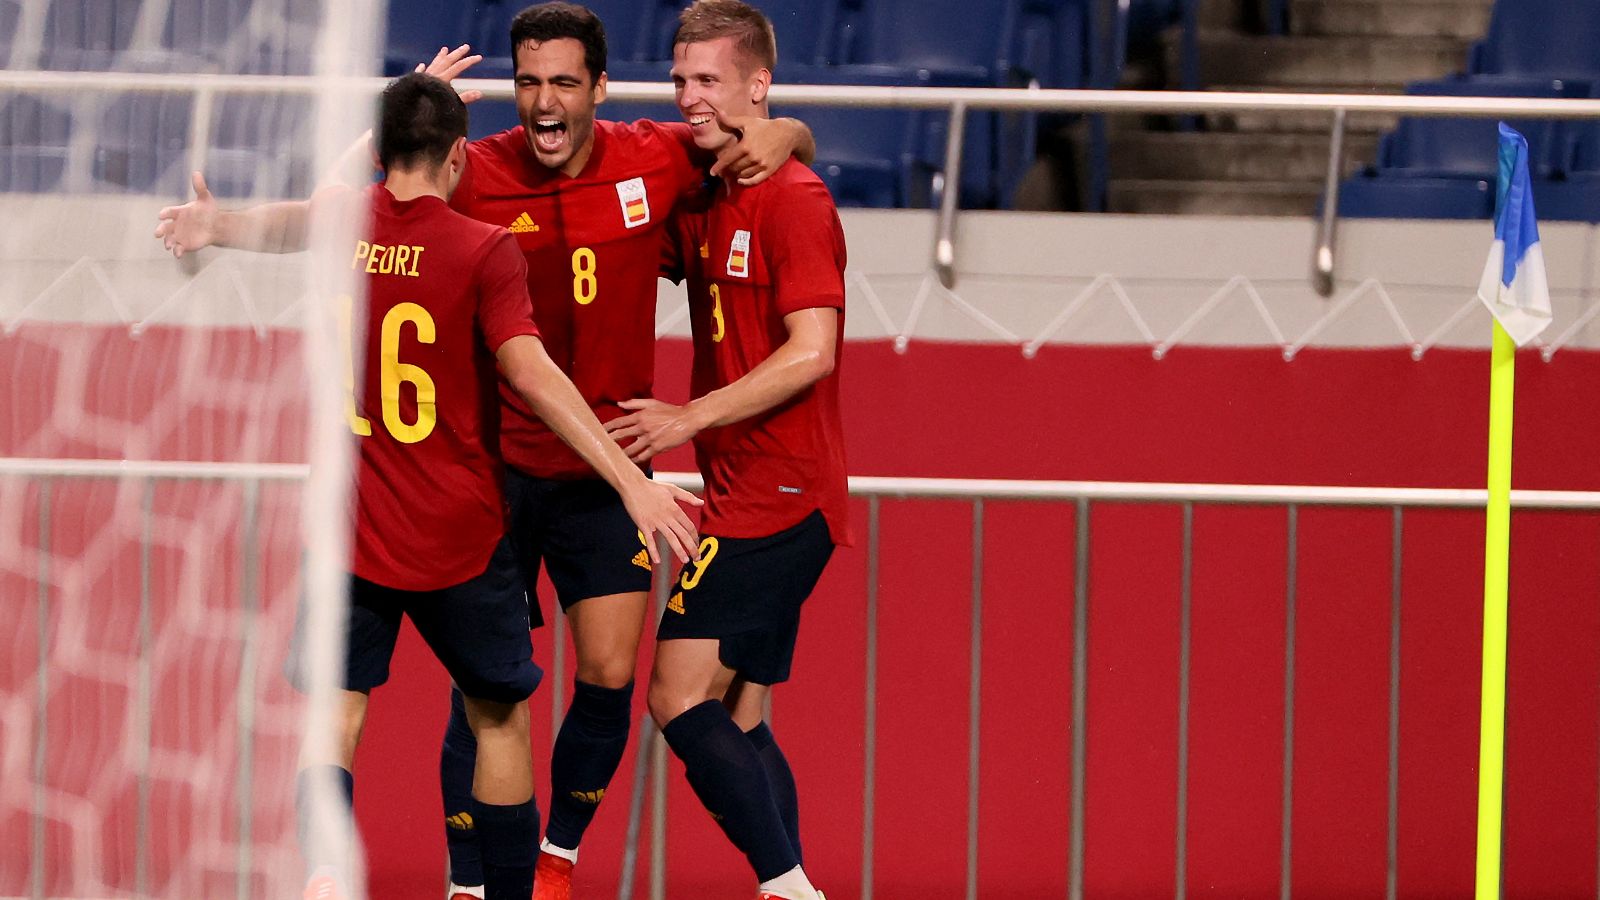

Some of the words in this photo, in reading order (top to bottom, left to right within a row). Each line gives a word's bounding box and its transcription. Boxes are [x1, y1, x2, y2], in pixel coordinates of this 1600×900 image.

[352, 240, 425, 277] PEDRI
[571, 247, 598, 305] 8
[681, 536, 719, 590] 9
